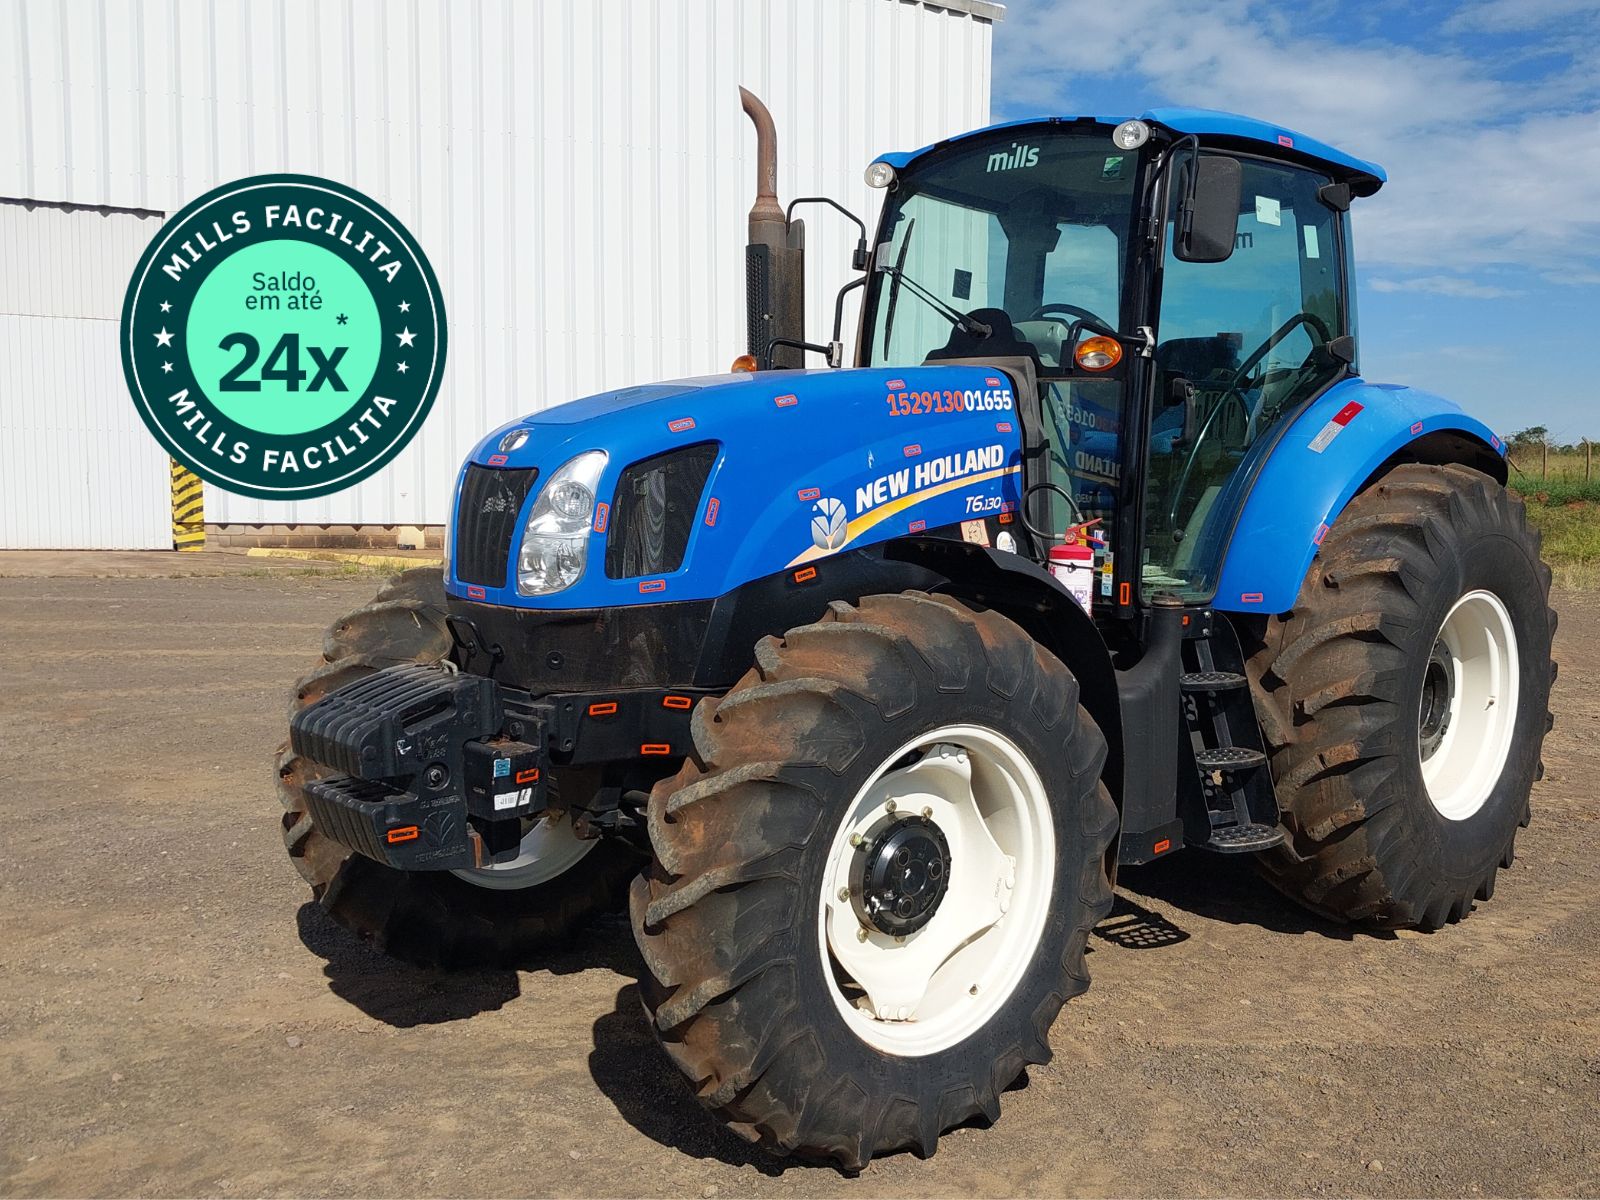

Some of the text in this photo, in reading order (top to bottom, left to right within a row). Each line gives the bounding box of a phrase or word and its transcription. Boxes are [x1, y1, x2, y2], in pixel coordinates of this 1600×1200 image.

[986, 142, 1040, 173] mills
[855, 444, 1004, 514] NEW HOLLAND
[966, 494, 1002, 514] T6.130
